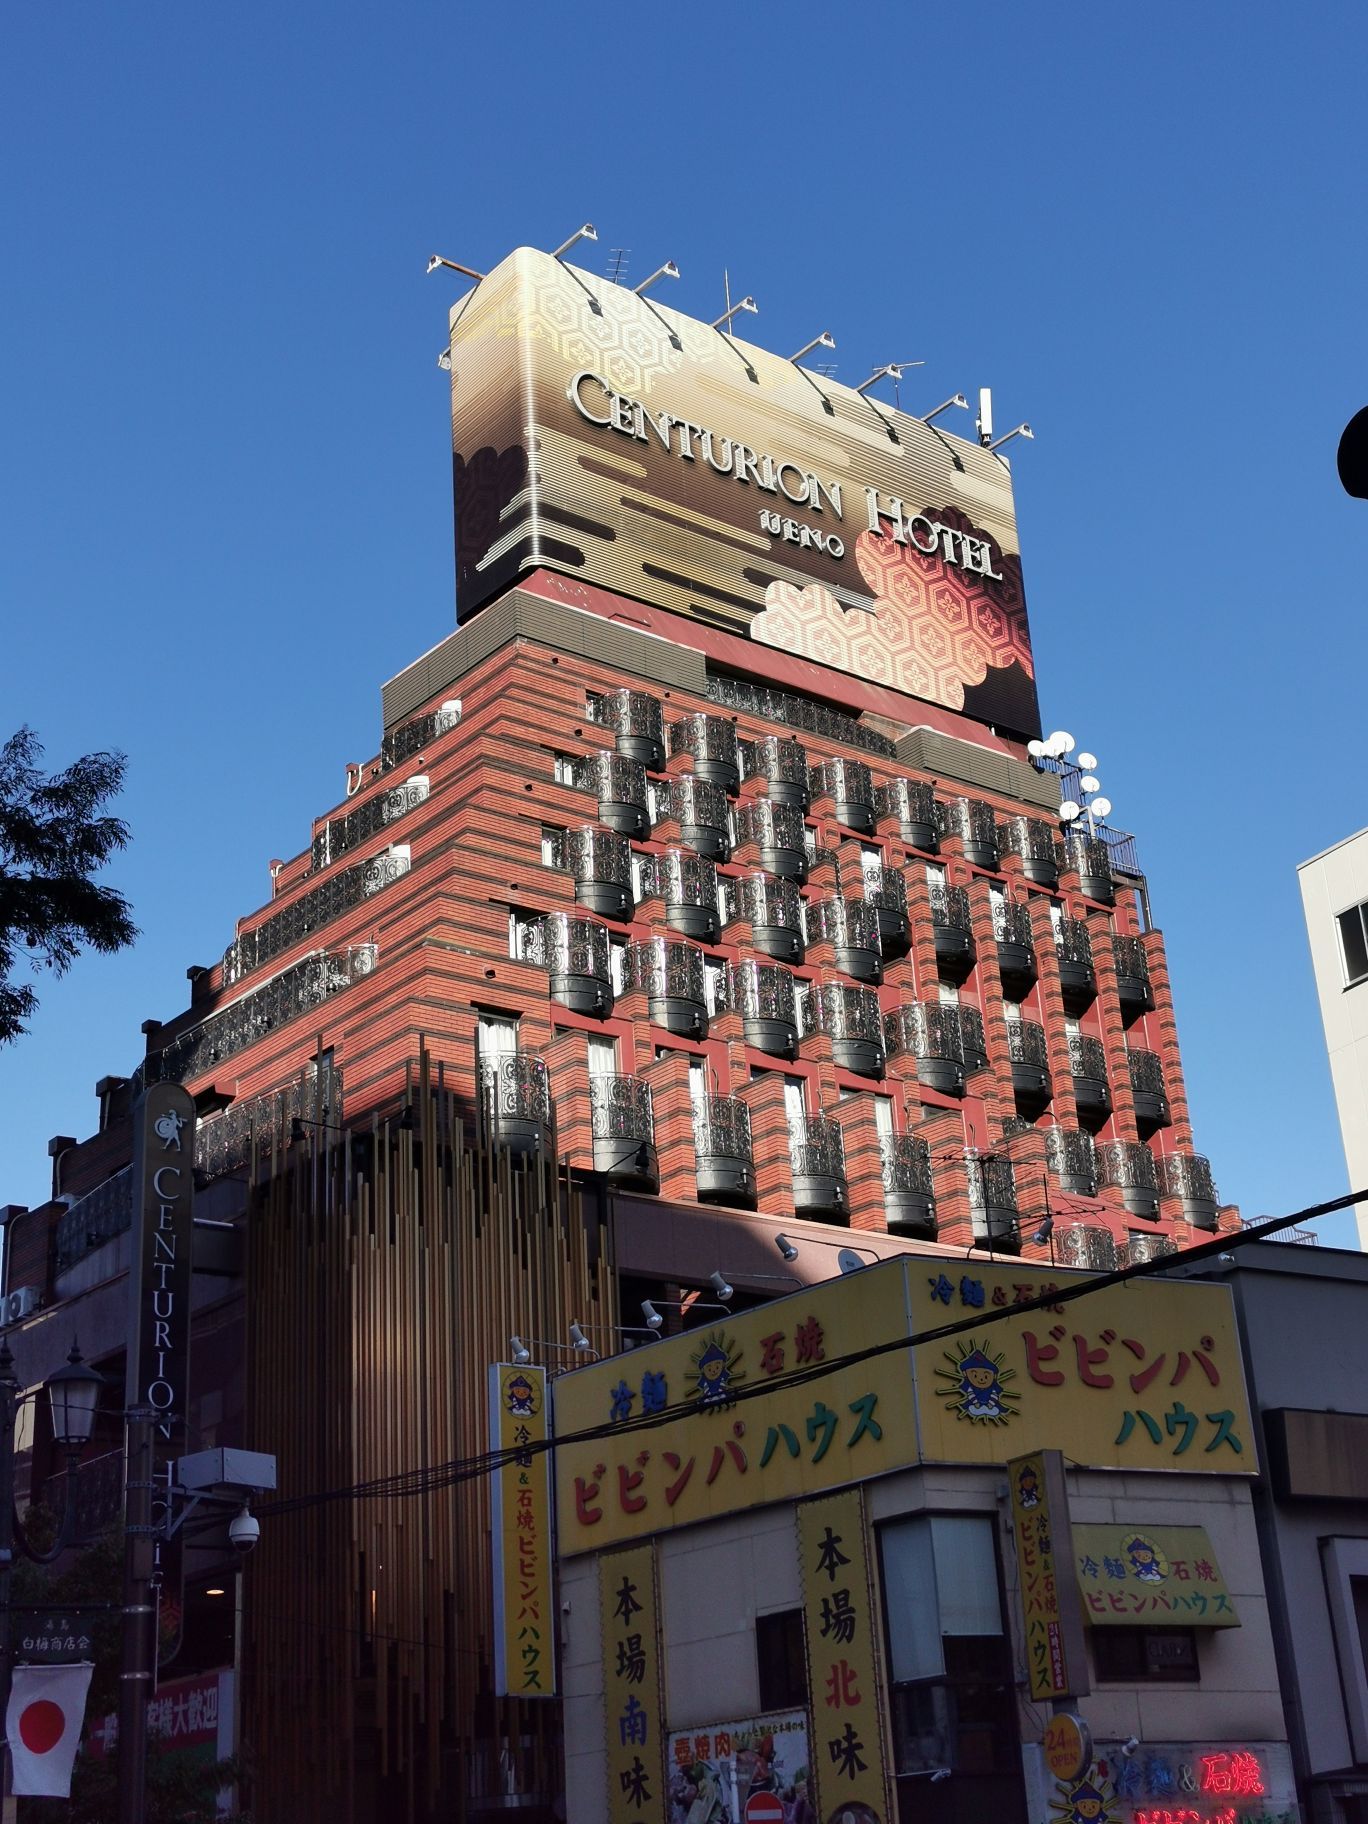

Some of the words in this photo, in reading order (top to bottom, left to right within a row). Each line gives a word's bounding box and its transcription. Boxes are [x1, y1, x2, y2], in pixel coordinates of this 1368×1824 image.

[567, 369, 845, 520] CENTURION
[865, 485, 1004, 581] HOTEL
[757, 508, 846, 560] UENO
[1021, 1324, 1221, 1394] ビビンパ
[1114, 1401, 1243, 1455] ハウス
[814, 1526, 869, 1781] 本場北味
[613, 1576, 654, 1810] 本場南味
[1051, 1752, 1078, 1768] OPEN
